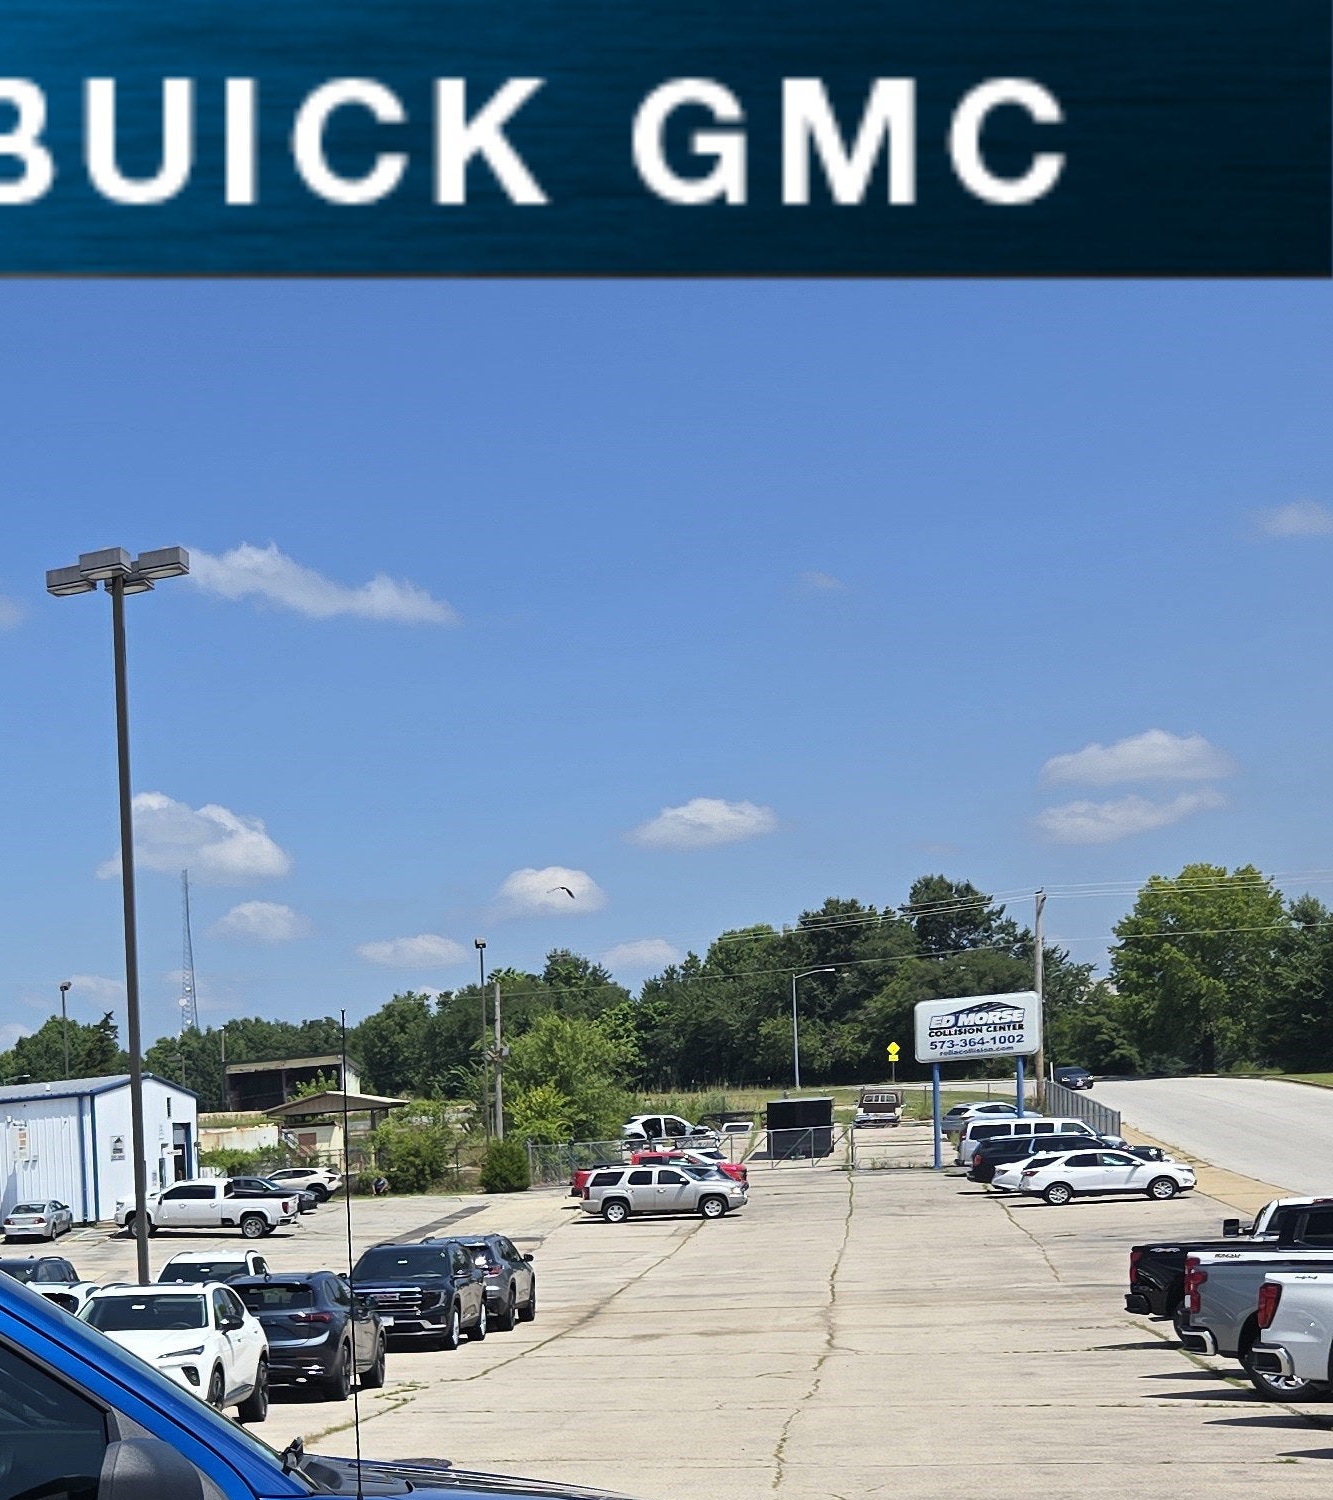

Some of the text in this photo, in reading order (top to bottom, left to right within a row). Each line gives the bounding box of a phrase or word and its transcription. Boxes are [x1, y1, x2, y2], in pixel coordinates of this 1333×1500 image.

[929, 1008, 1025, 1030] ED MORSE
[928, 1023, 1024, 1037] COLLISION CENTER
[929, 1034, 1024, 1050] 573-364-1002
[939, 1046, 1014, 1056] rollacollision.com
